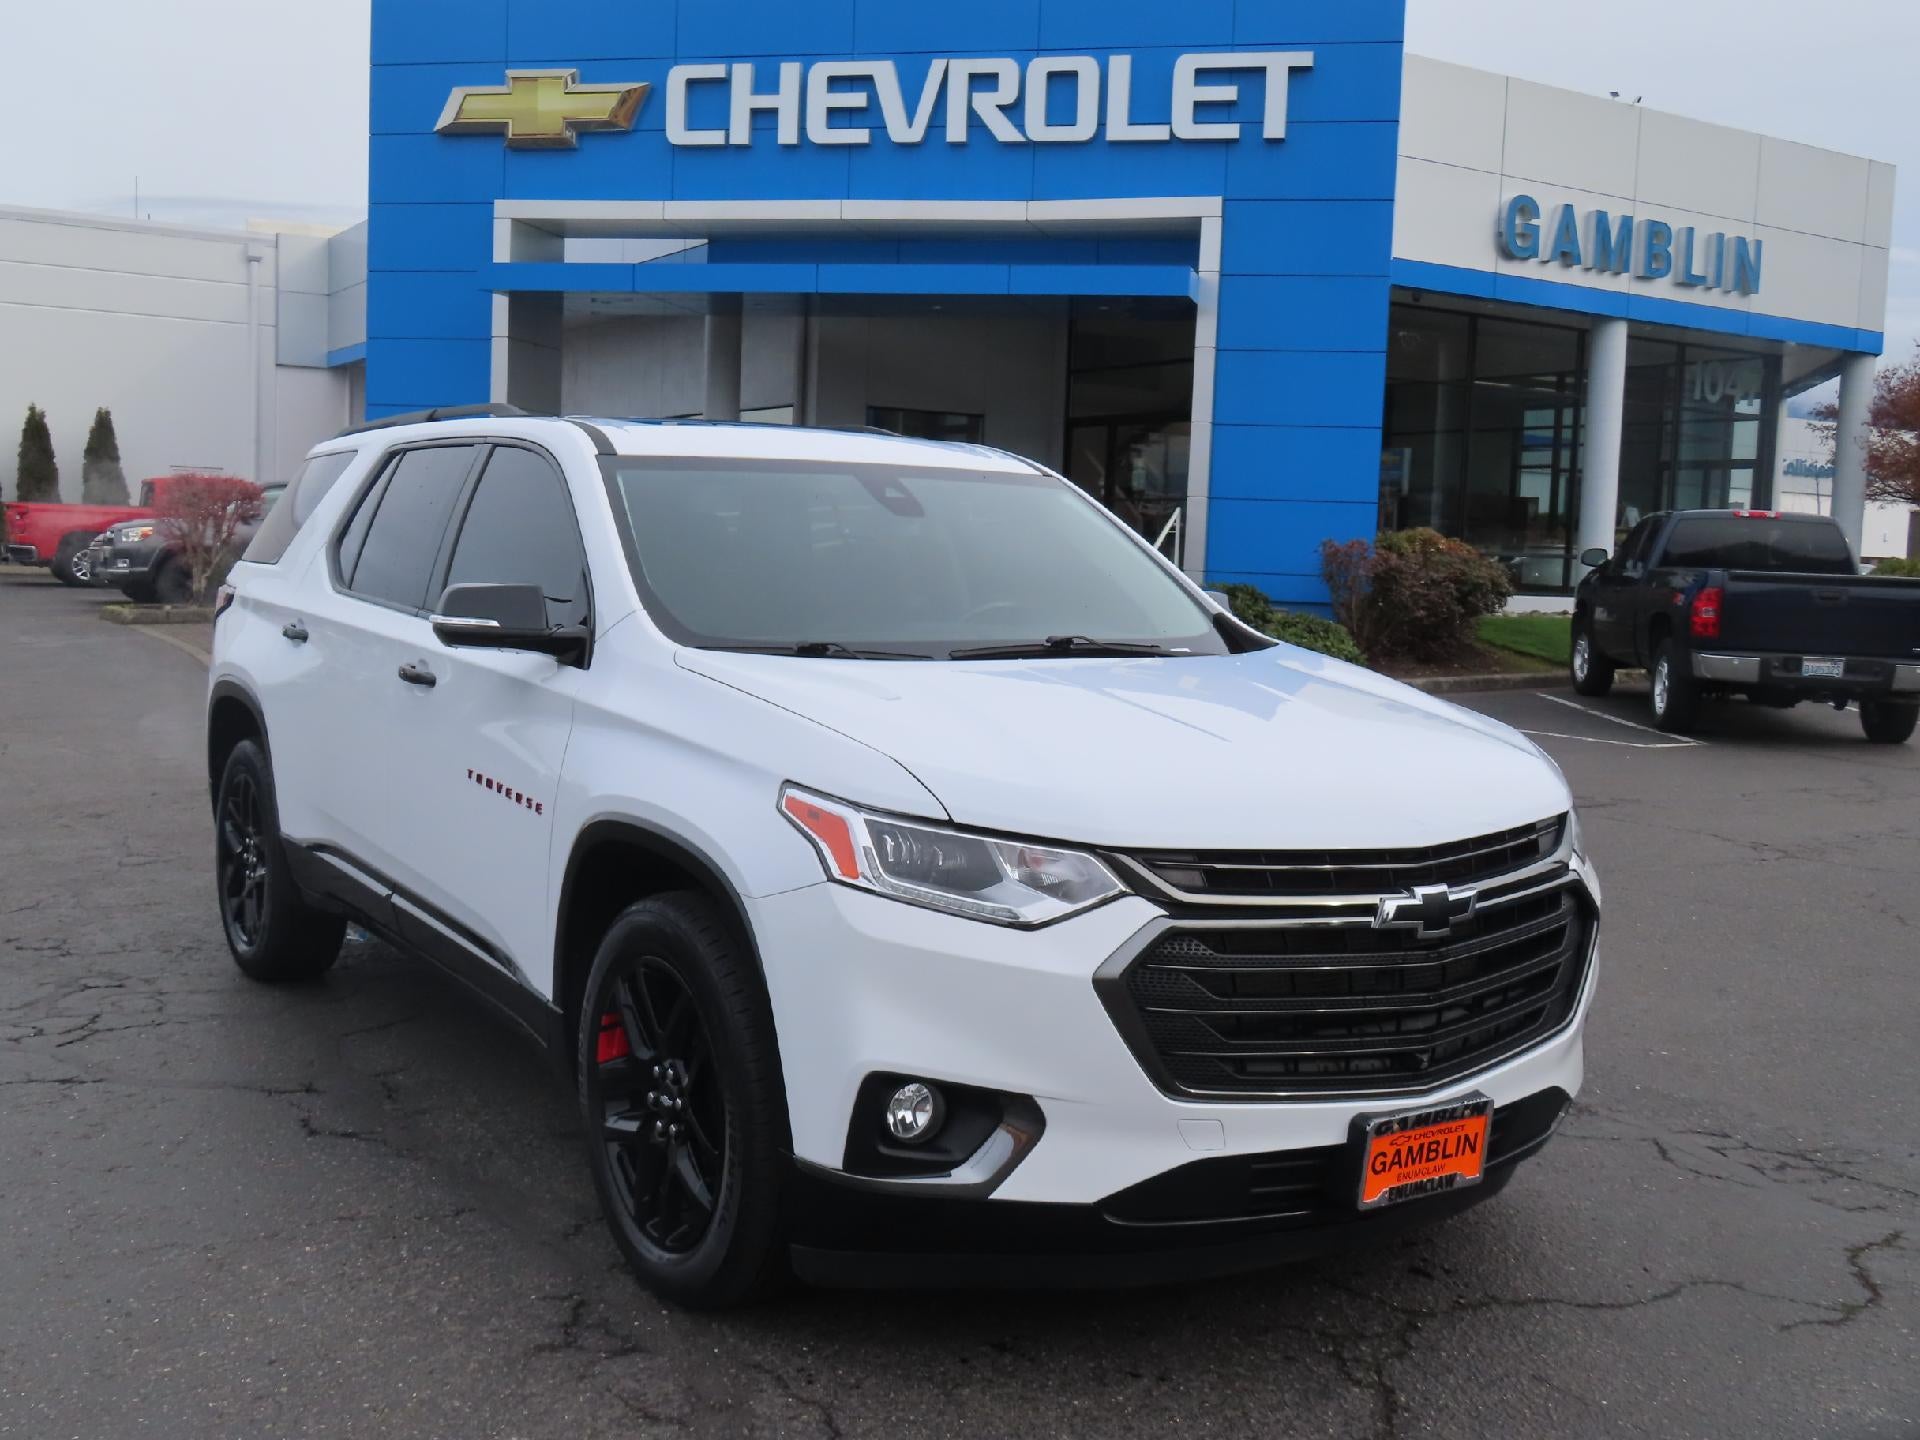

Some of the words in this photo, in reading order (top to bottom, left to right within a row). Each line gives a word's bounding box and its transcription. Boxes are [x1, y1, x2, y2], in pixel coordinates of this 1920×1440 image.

[665, 50, 1315, 147] CHEVROLET
[1502, 194, 1763, 296] GAMBLIN
[466, 768, 543, 816] TRAVERSE
[1371, 1131, 1479, 1176] GAMBLIN
[1413, 1124, 1466, 1142] CHEVROLET
[1388, 1173, 1458, 1201] ENUMCLAW
[1396, 1162, 1446, 1183] ENUMCLAW
